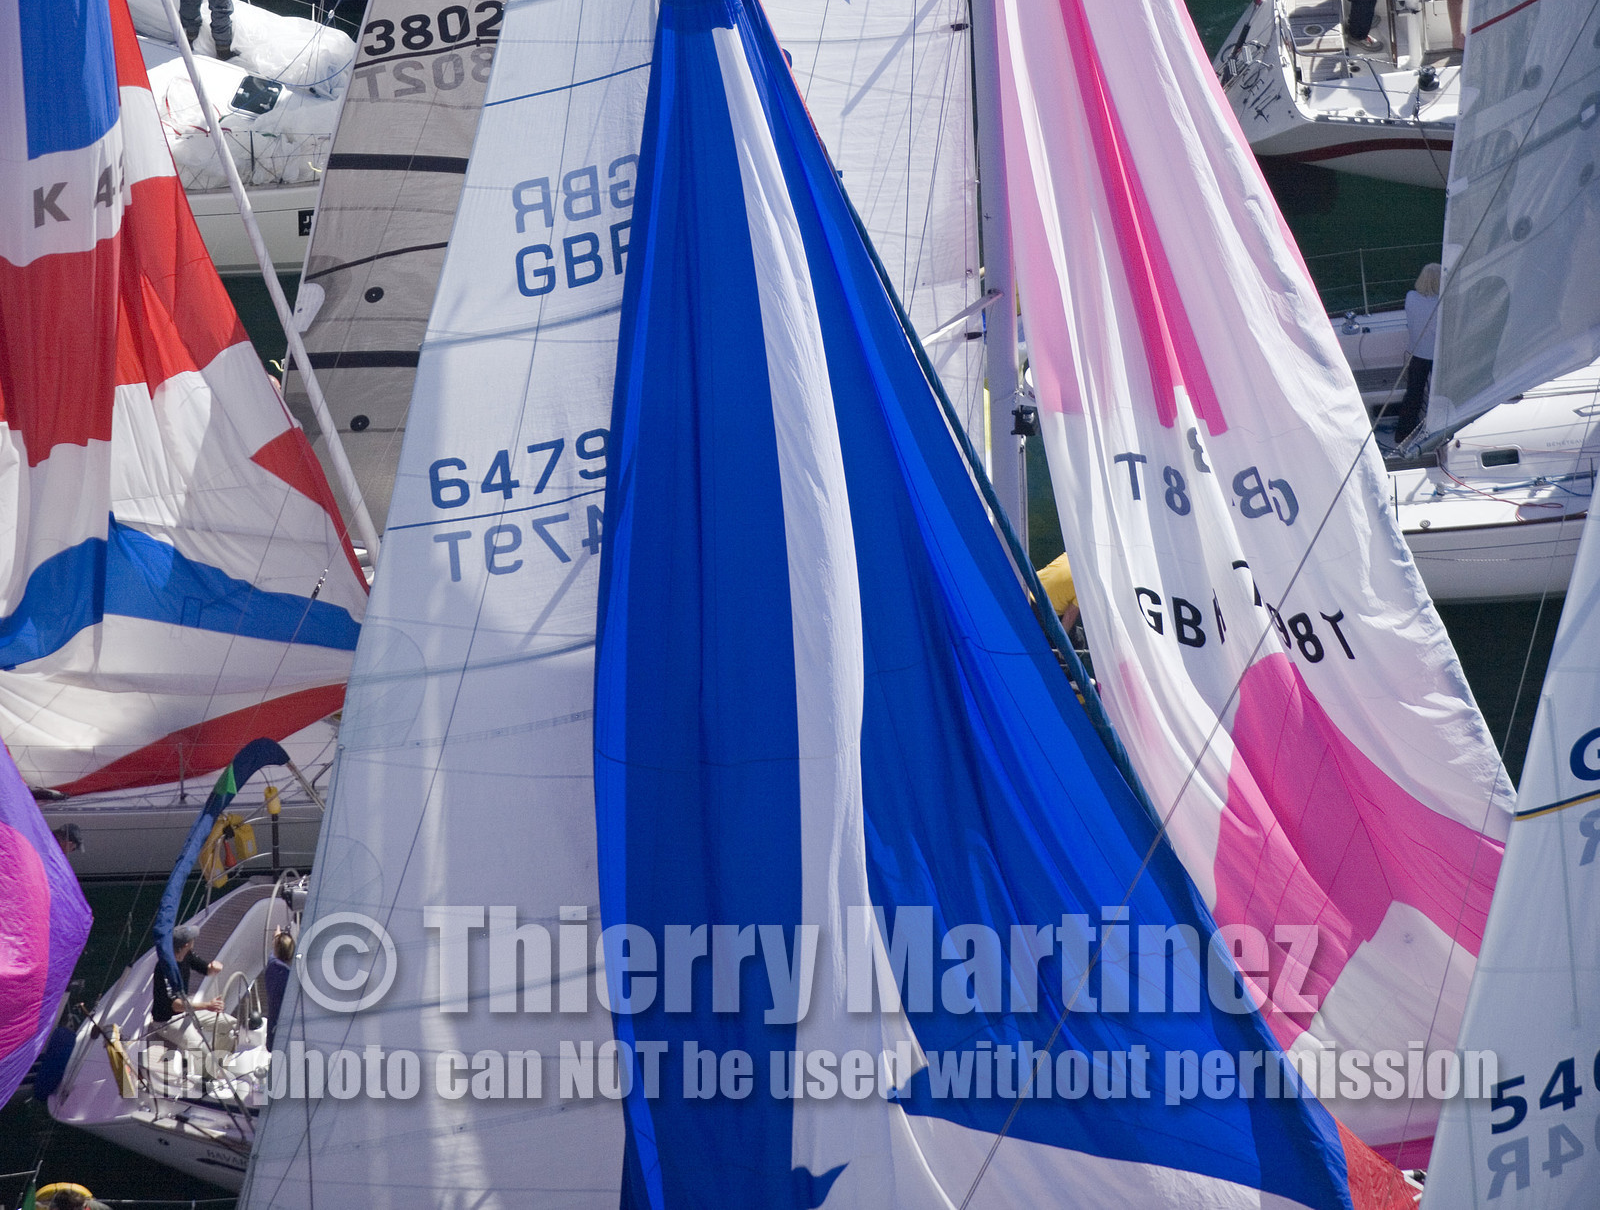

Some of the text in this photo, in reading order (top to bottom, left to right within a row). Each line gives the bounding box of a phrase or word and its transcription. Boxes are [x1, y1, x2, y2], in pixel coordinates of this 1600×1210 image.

[364, 0, 505, 57] 3802
[33, 181, 71, 229] K
[429, 428, 611, 509] 6479
